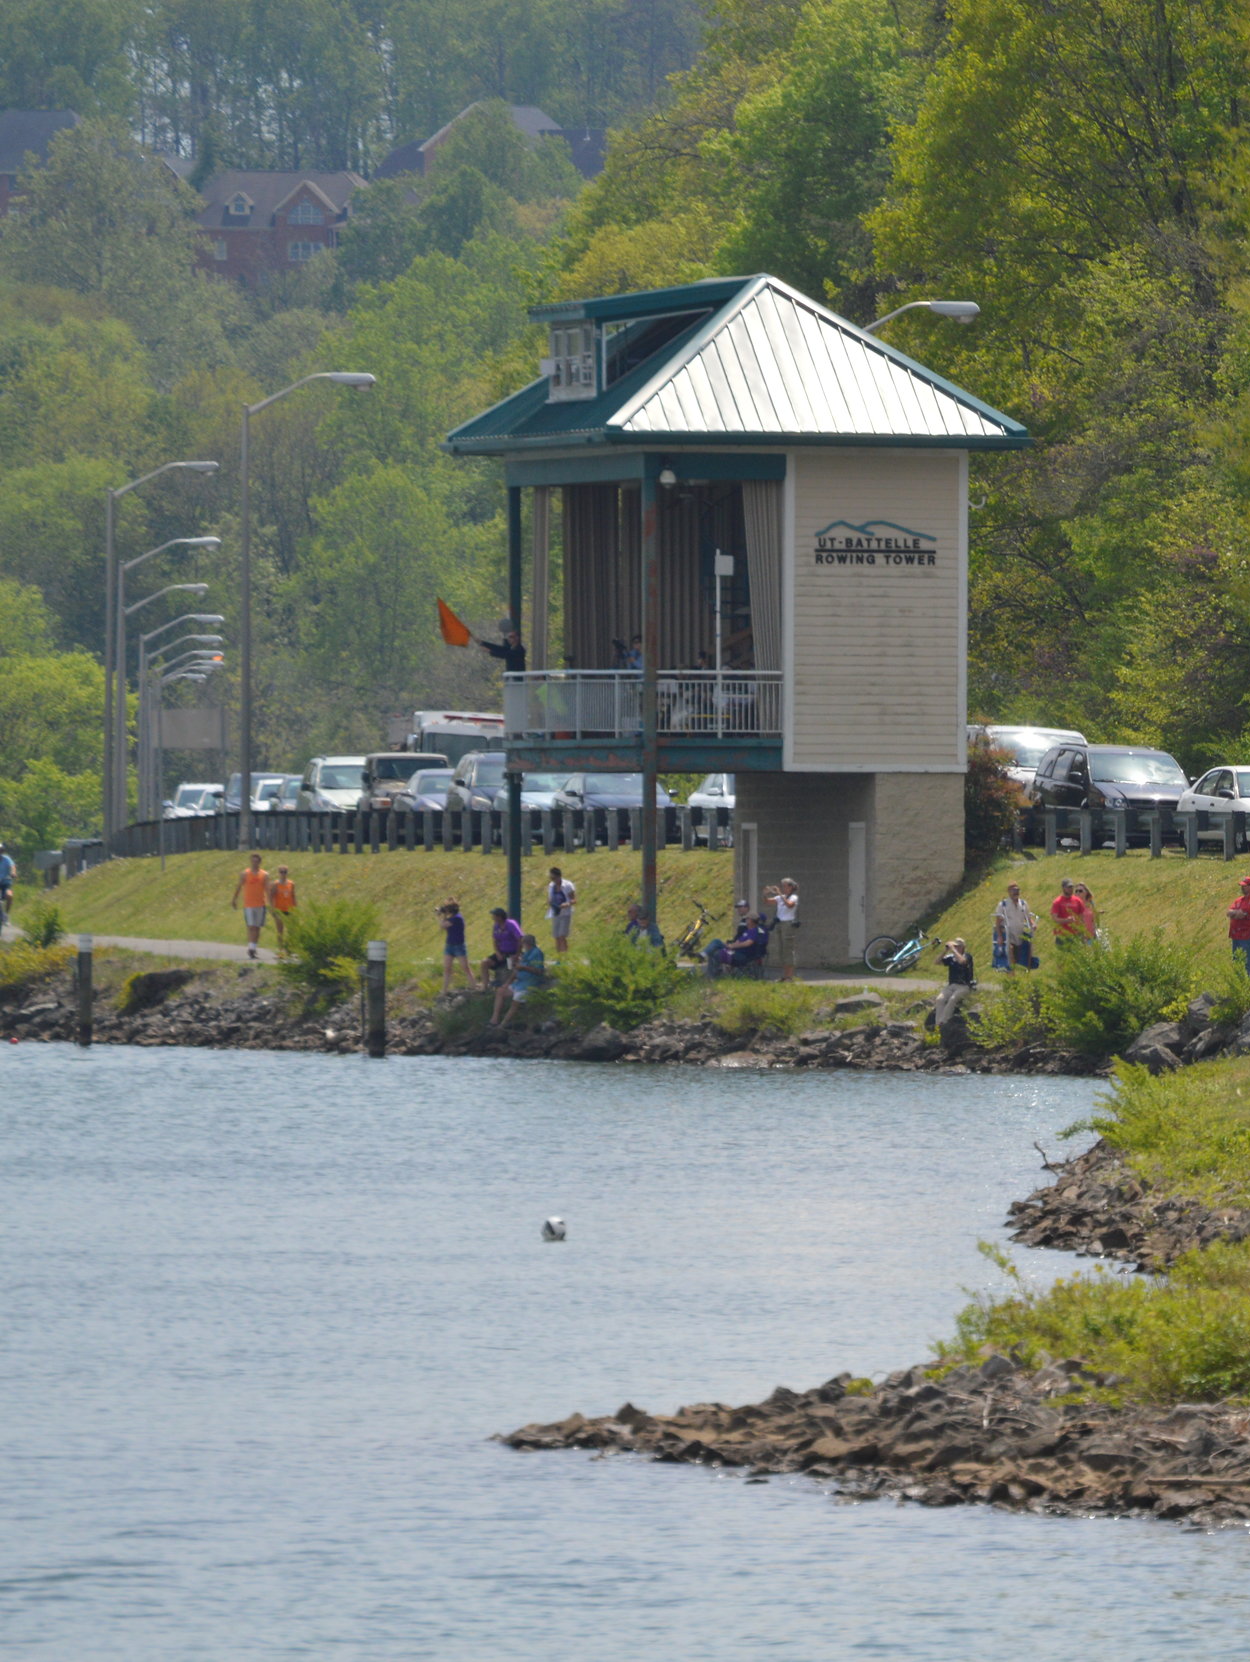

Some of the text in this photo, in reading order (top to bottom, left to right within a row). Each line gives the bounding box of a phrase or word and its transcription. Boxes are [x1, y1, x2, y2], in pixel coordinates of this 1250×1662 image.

[818, 538, 920, 549] UT-BATTELLE
[815, 554, 937, 566] ROWING TOWER
